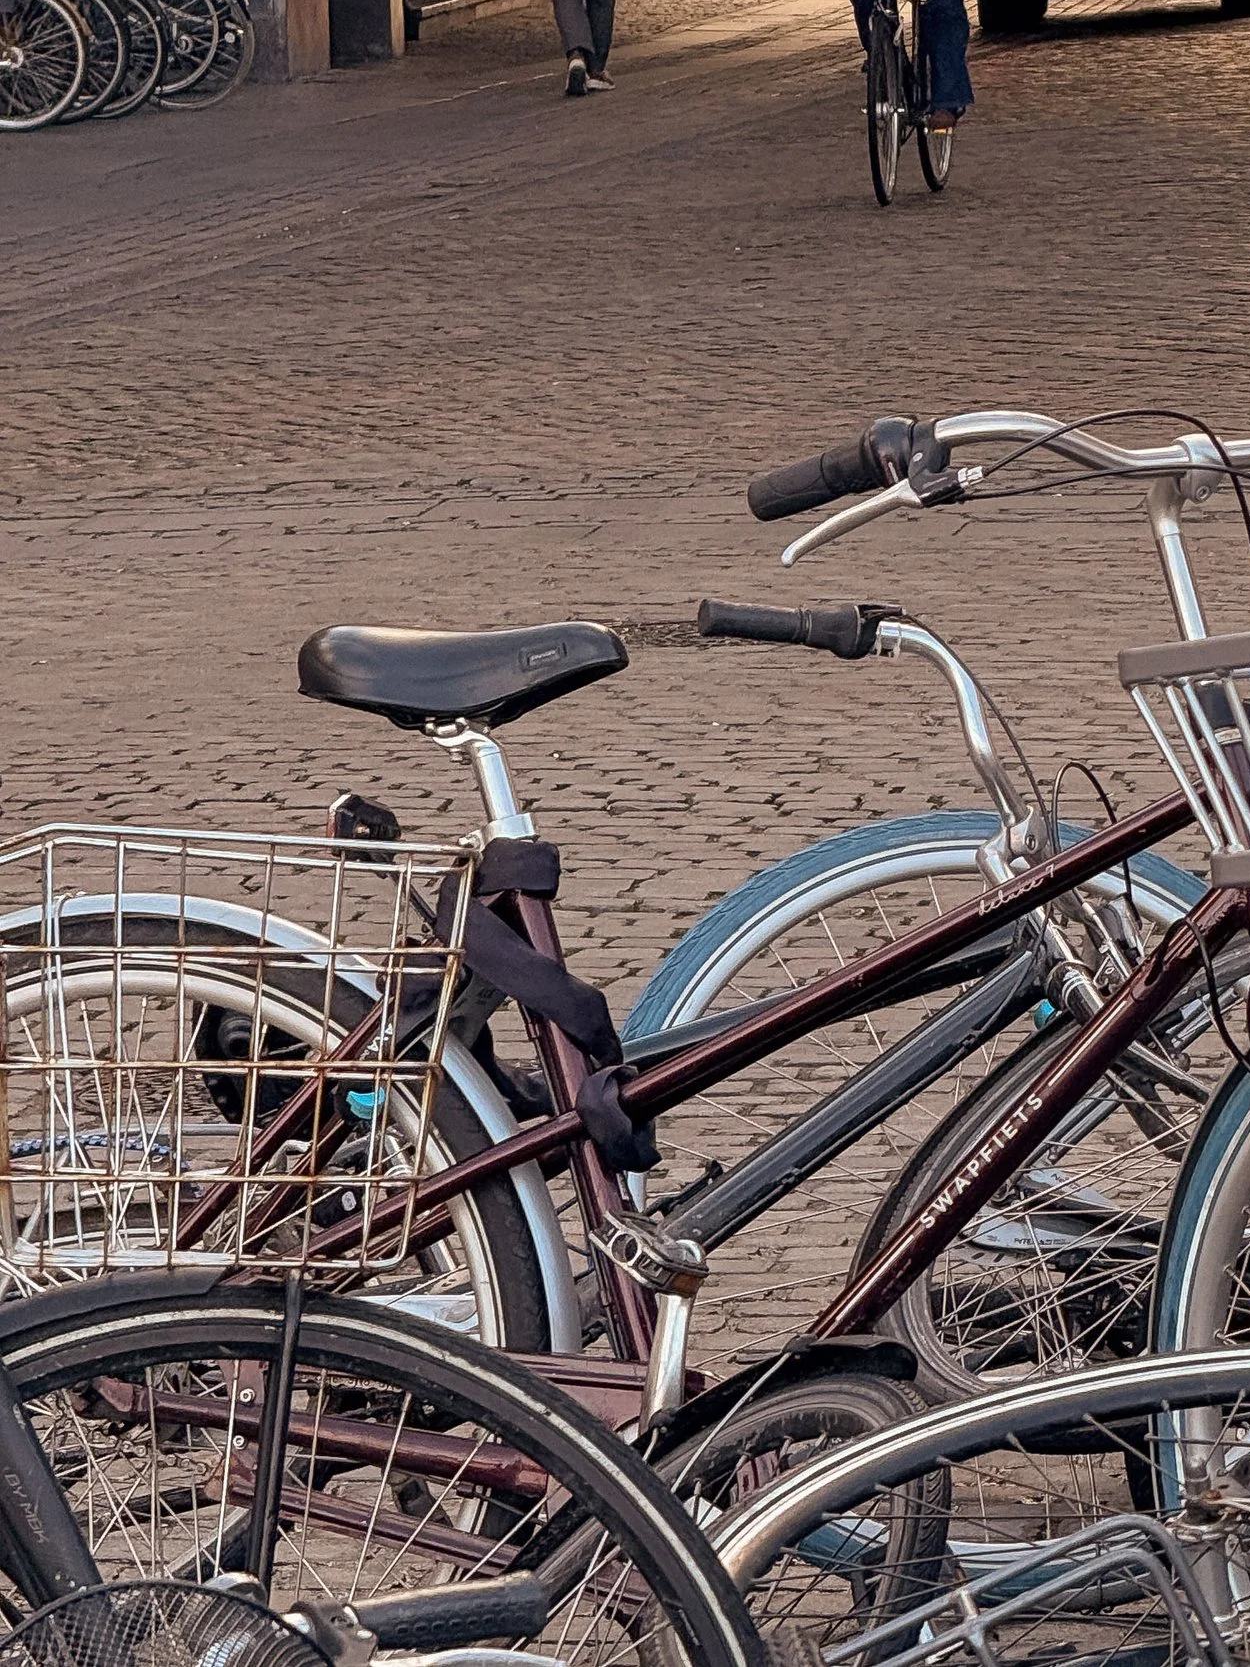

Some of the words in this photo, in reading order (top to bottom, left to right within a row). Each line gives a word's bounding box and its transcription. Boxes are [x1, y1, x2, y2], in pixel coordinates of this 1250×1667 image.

[1045, 862, 1054, 878] 7
[919, 1093, 1043, 1229] SWAPFIETS
[4, 1474, 28, 1498] BY
[20, 1503, 50, 1544] MBK
